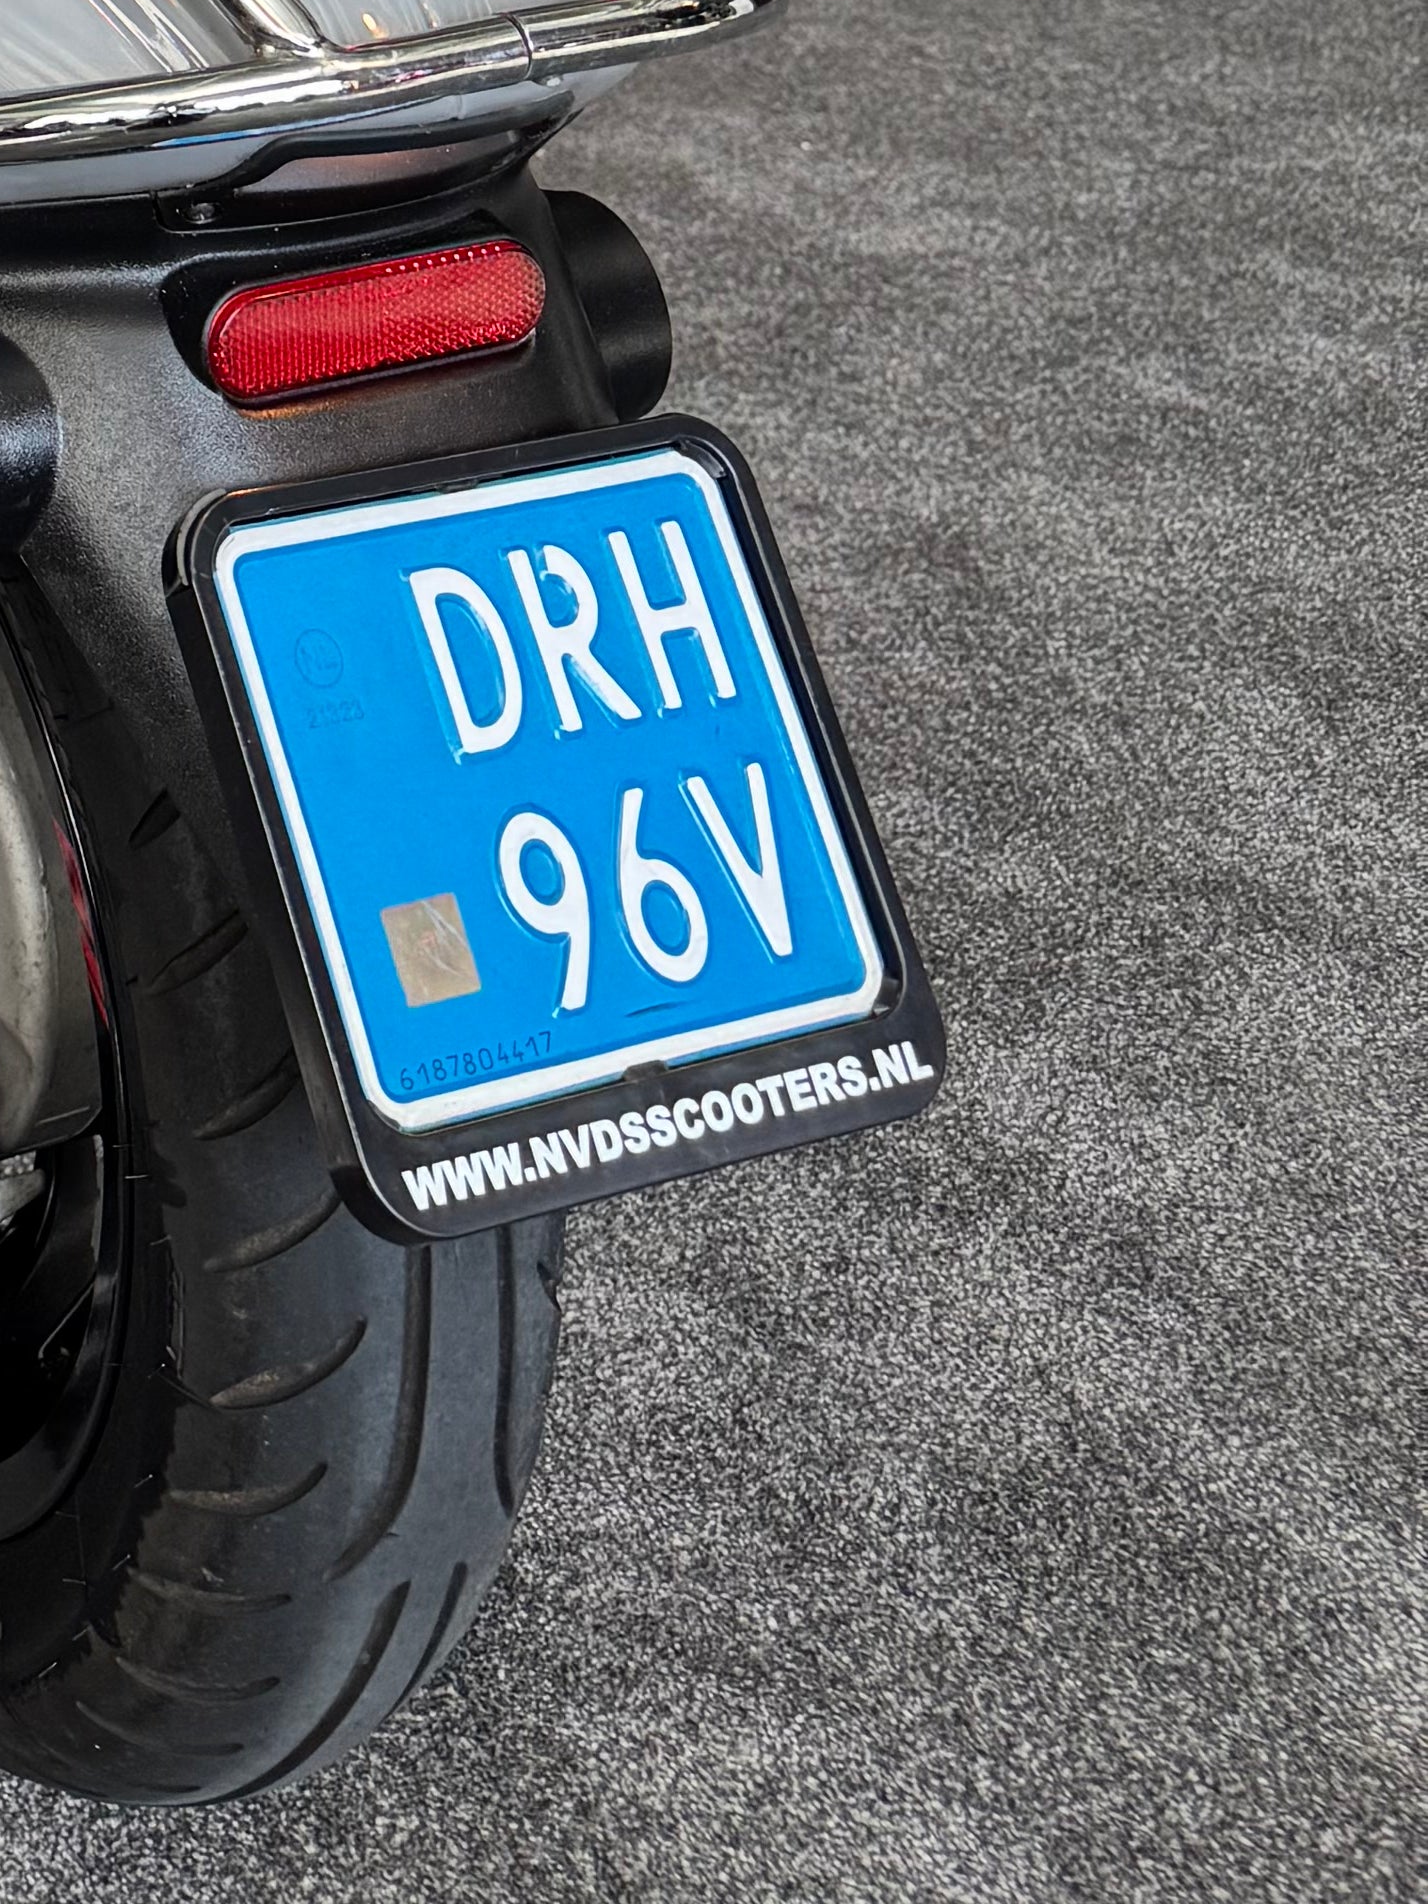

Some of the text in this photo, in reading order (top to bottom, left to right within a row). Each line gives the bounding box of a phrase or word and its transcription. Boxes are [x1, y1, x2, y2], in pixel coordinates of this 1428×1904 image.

[409, 520, 737, 754] DRH
[499, 762, 793, 1010] 96V
[399, 1030, 552, 1091] 6187804417
[401, 1040, 935, 1212] WWW.NVDSSCOOTERS.NL
